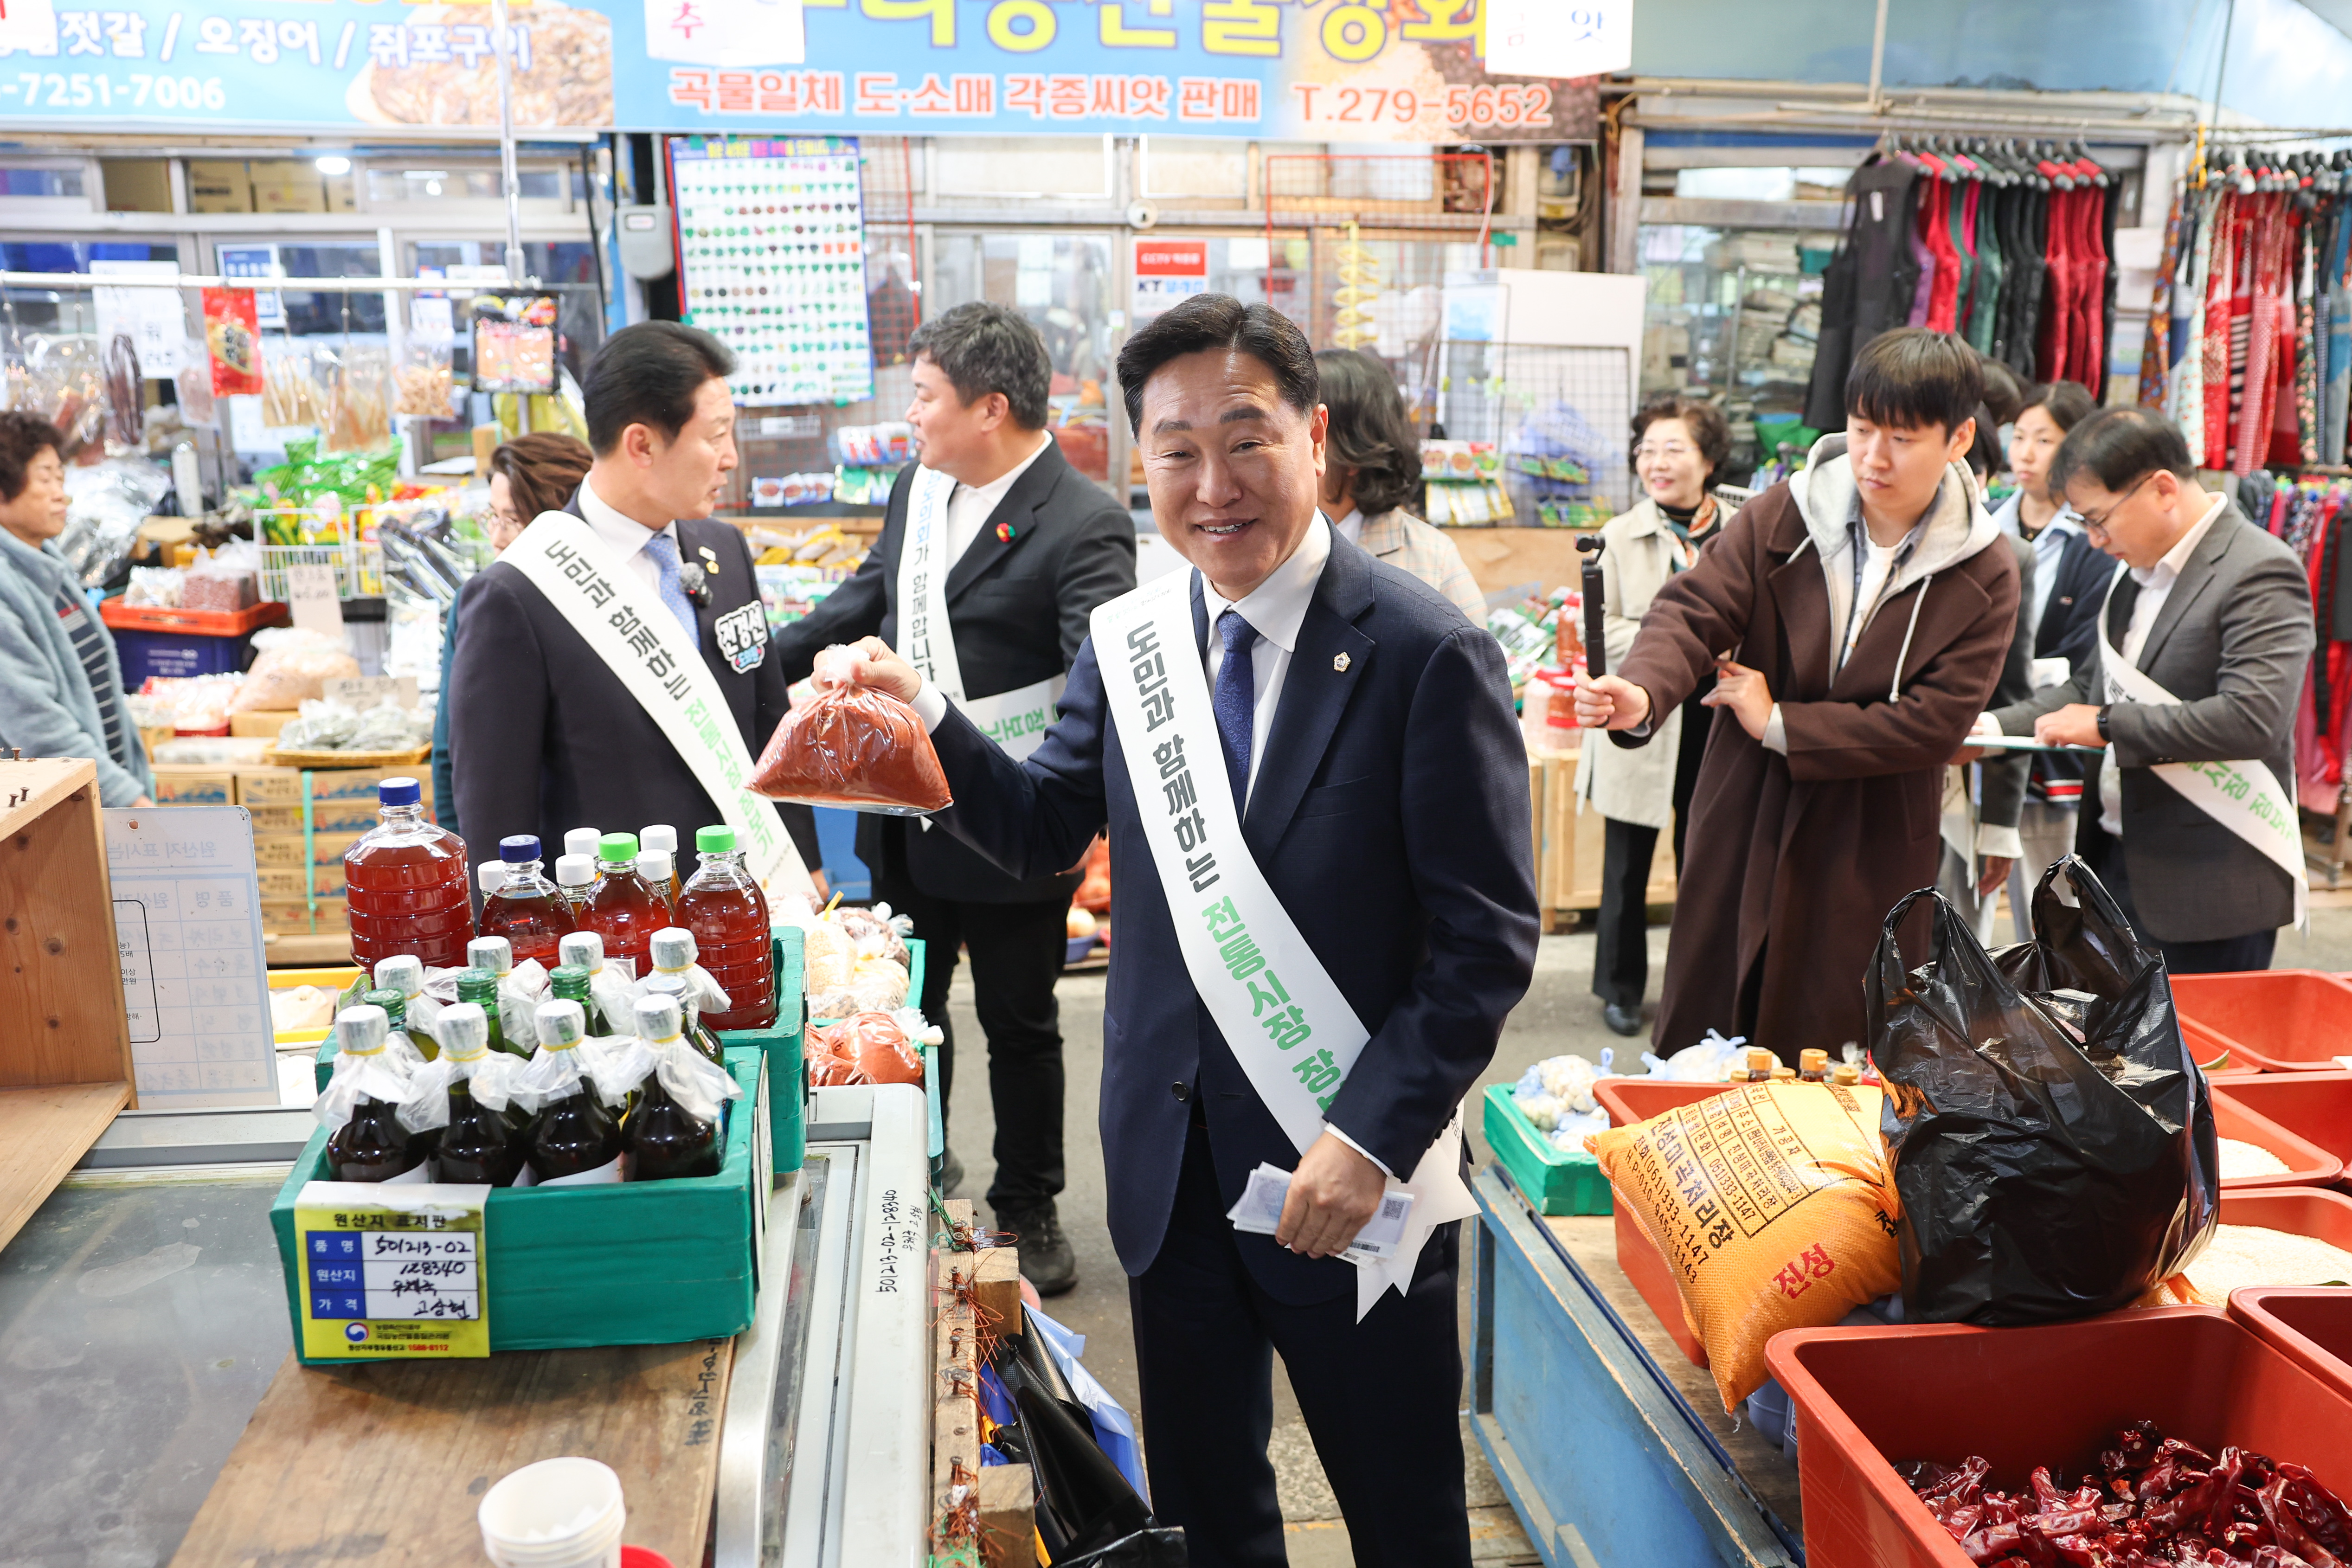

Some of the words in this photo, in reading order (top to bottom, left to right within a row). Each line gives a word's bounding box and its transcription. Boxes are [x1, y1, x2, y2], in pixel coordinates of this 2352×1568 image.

[196, 18, 322, 65] 오징어
[369, 22, 532, 71] 쥐포구이
[672, 70, 842, 113] 곡물일체
[1007, 74, 1167, 117] 각종씨앗
[1181, 78, 1258, 121] 판매
[1294, 85, 1553, 127] T.279-5652
[1137, 280, 1162, 291] KT
[720, 605, 765, 655] 전경선
[912, 571, 935, 682] 함께합니다
[545, 540, 617, 607] 도민과
[608, 604, 692, 701] 함께하는
[683, 697, 743, 790] 전통시장
[1126, 620, 1175, 733] 도민과
[1152, 734, 1220, 893] 함께하는
[1201, 895, 1311, 1051] 전통시장
[1736, 1110, 1754, 1128] 주소
[1772, 1125, 1802, 1157] 가공자
[1651, 1117, 1735, 1249] 진성미곡처리장
[1694, 1131, 1713, 1152] 전화
[1709, 1158, 1756, 1221] 061)333-1147
[1714, 1120, 1734, 1140] 성명
[1728, 1144, 1779, 1209] 진성미곡처리장
[334, 1214, 385, 1227] 원산지
[375, 1234, 473, 1256] 501213-02
[875, 1189, 901, 1293] 501213-02-128340
[316, 1269, 356, 1282] 원산지
[399, 1260, 466, 1278] 128340
[1772, 1243, 1836, 1299] 진성
